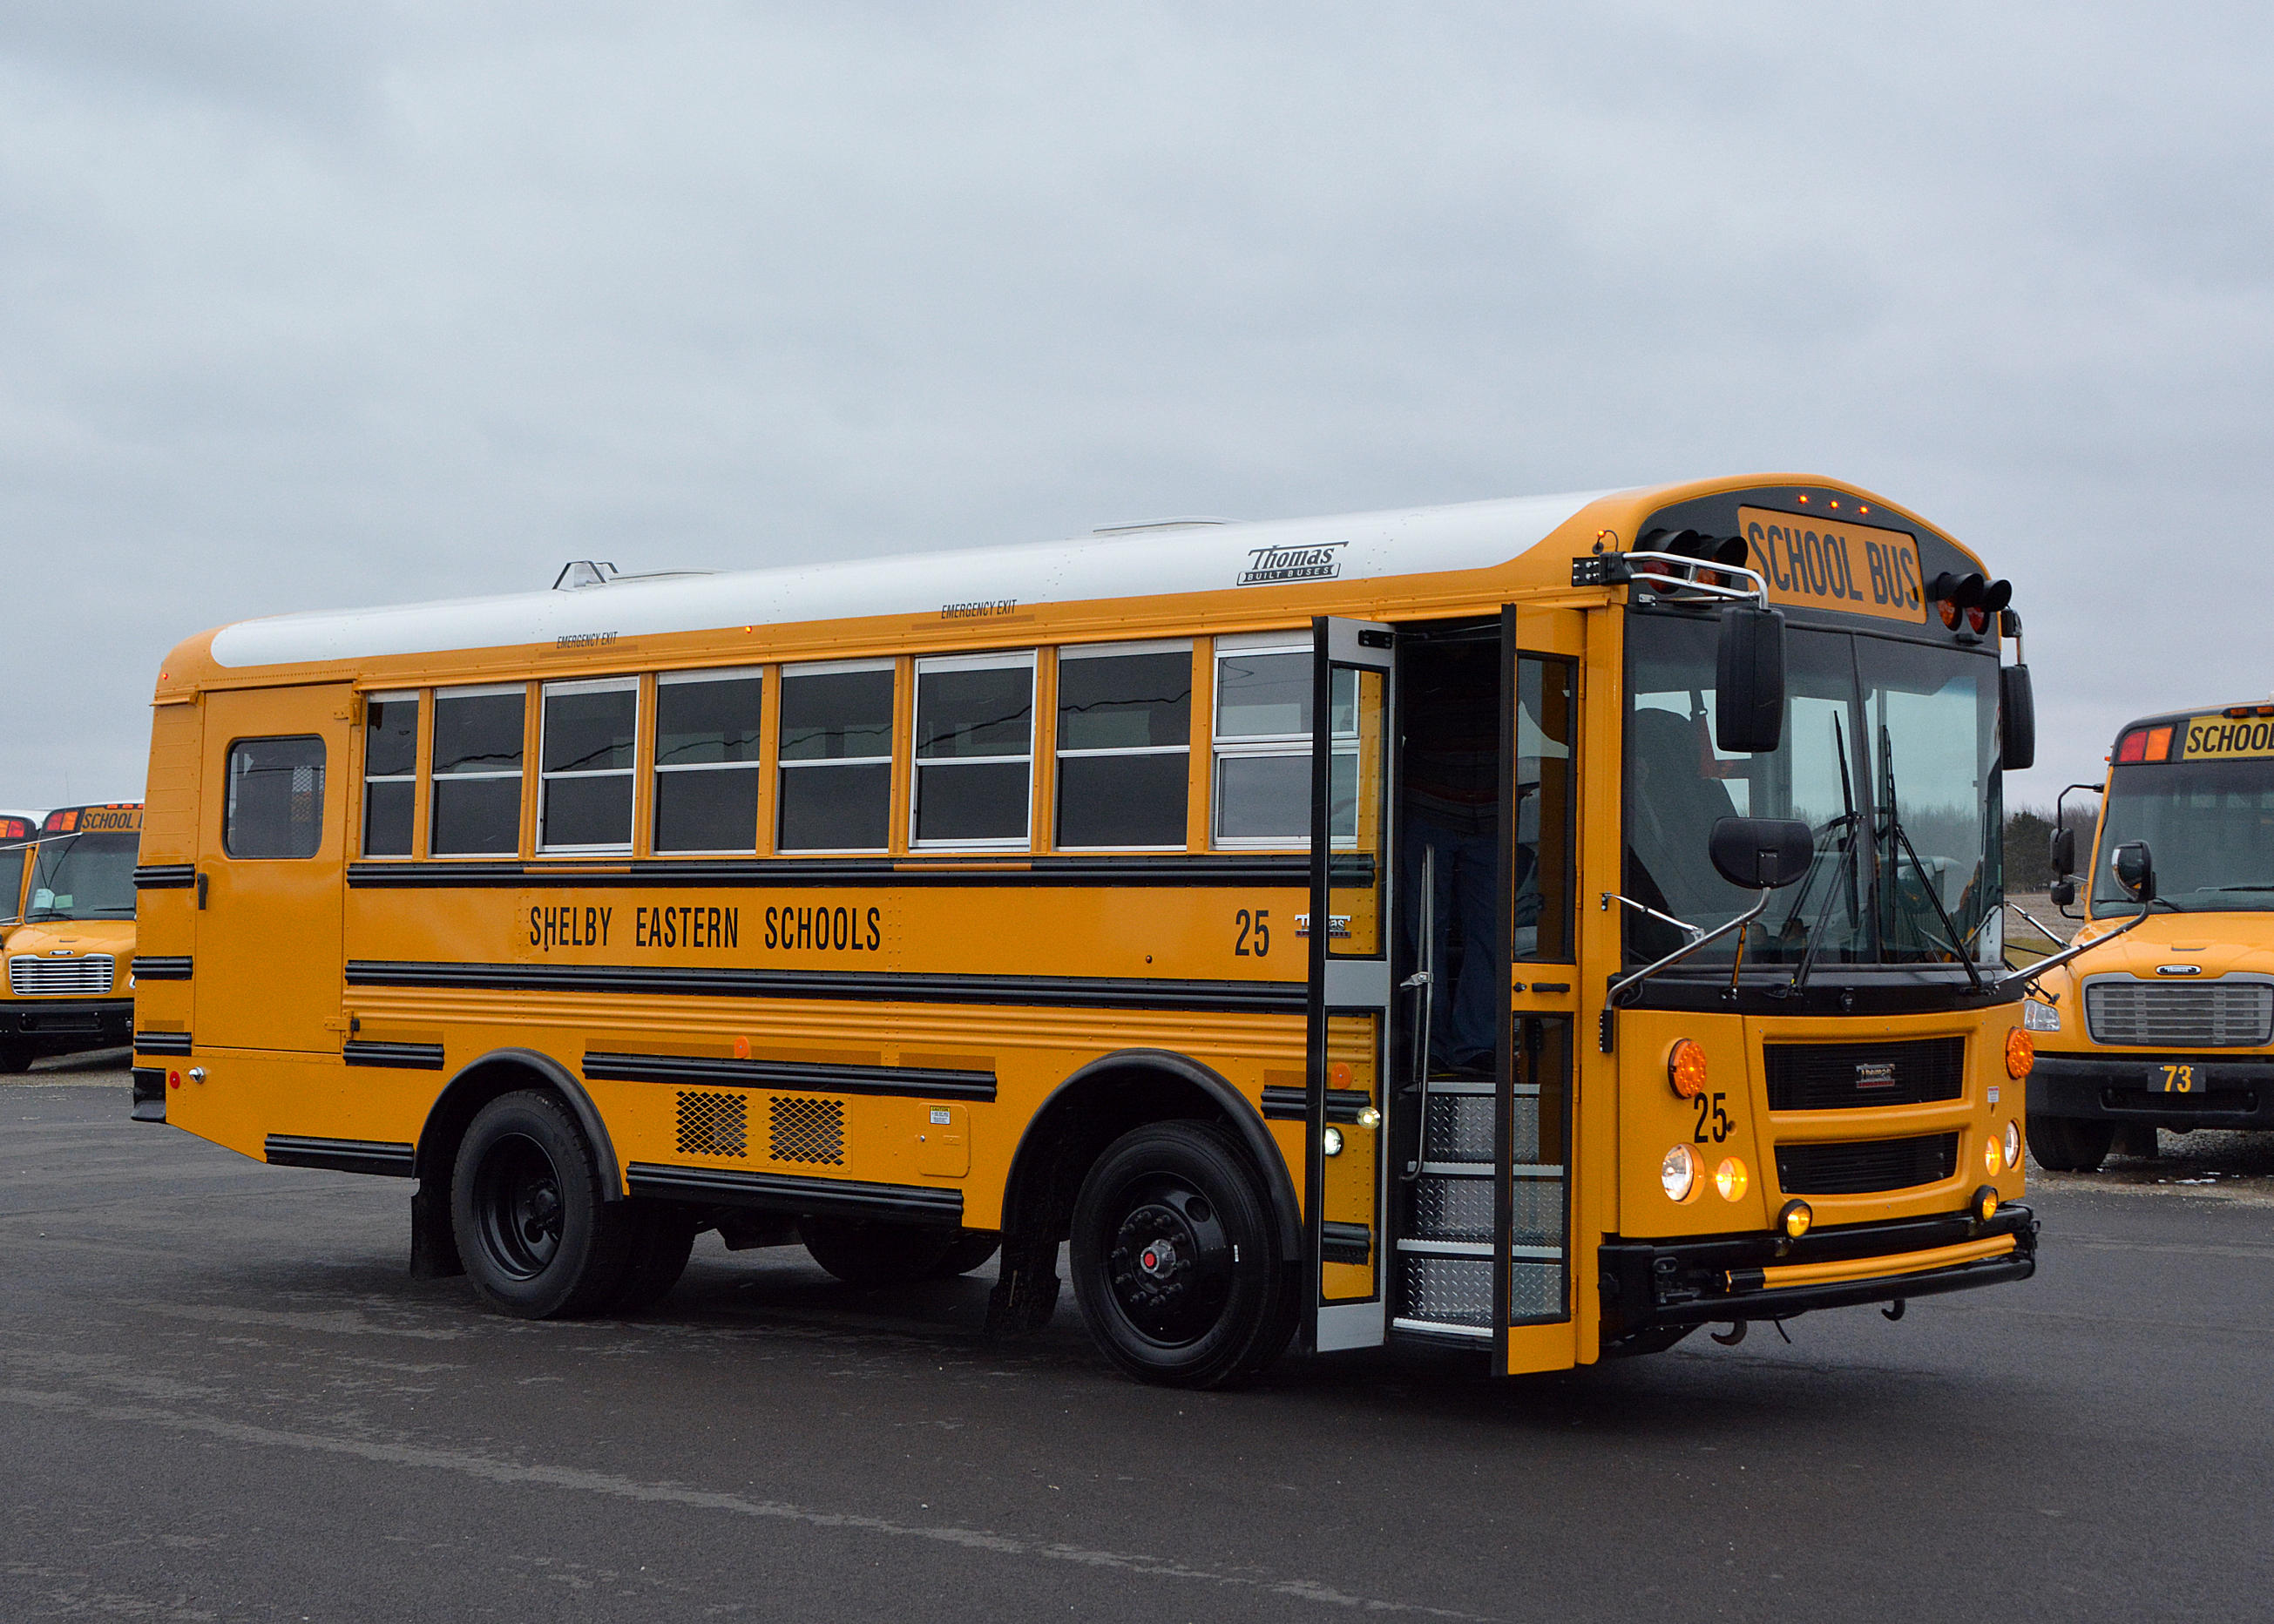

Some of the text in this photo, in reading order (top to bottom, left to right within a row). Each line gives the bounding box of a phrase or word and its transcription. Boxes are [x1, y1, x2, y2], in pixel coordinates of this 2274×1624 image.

[1248, 541, 1349, 570] Thomas
[1748, 521, 1919, 611] SCHOOL BUS
[1247, 566, 1330, 581] BUILT BUSES
[941, 599, 1017, 619] EMERGENCY EXIT
[557, 631, 618, 648] EMERGENCY EXIT
[83, 813, 133, 829] SCHOOL
[530, 906, 880, 951] SHELBY EASTERN SCHOOLS
[1235, 909, 1269, 957] 25
[2162, 1065, 2192, 1093] 73
[1694, 1092, 1727, 1143] 25
